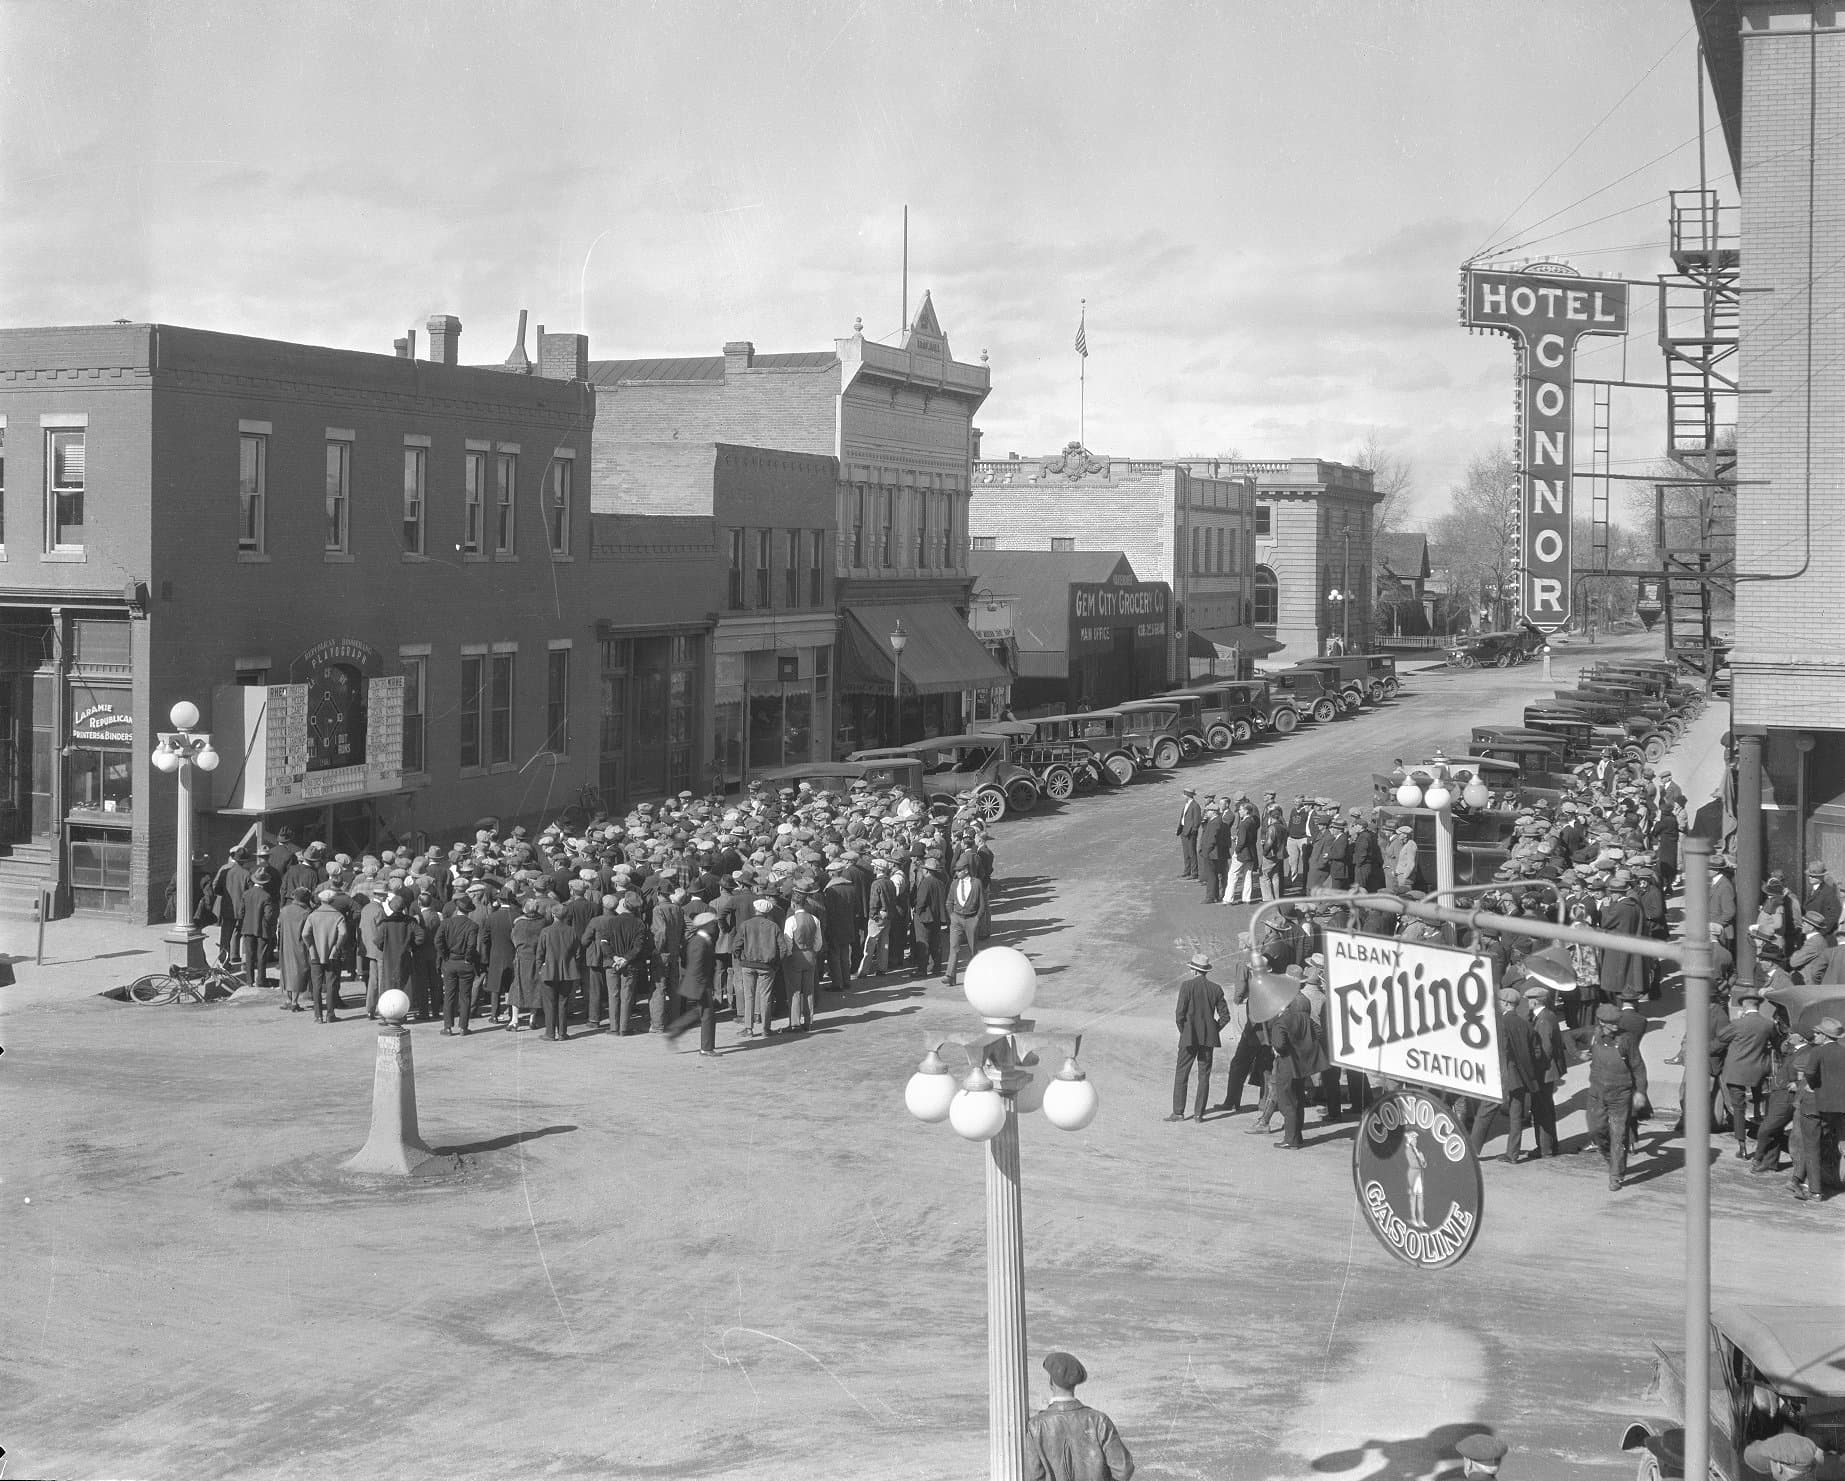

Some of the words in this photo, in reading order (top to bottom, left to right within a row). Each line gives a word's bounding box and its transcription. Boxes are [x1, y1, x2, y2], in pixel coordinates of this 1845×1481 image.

[1482, 283, 1616, 322] HOTEL
[1532, 333, 1565, 612] CONNOR
[1076, 590, 1095, 617] GEM
[1098, 589, 1117, 616] CITY
[1119, 590, 1153, 616] GROCERY
[75, 703, 113, 724] LARAMIE
[1335, 941, 1404, 968] ALBANY
[1334, 959, 1491, 1057] Filling
[1405, 1048, 1487, 1085] STATION
[1367, 1096, 1466, 1162] CONOCO
[1365, 1180, 1473, 1263] GASOLINE
